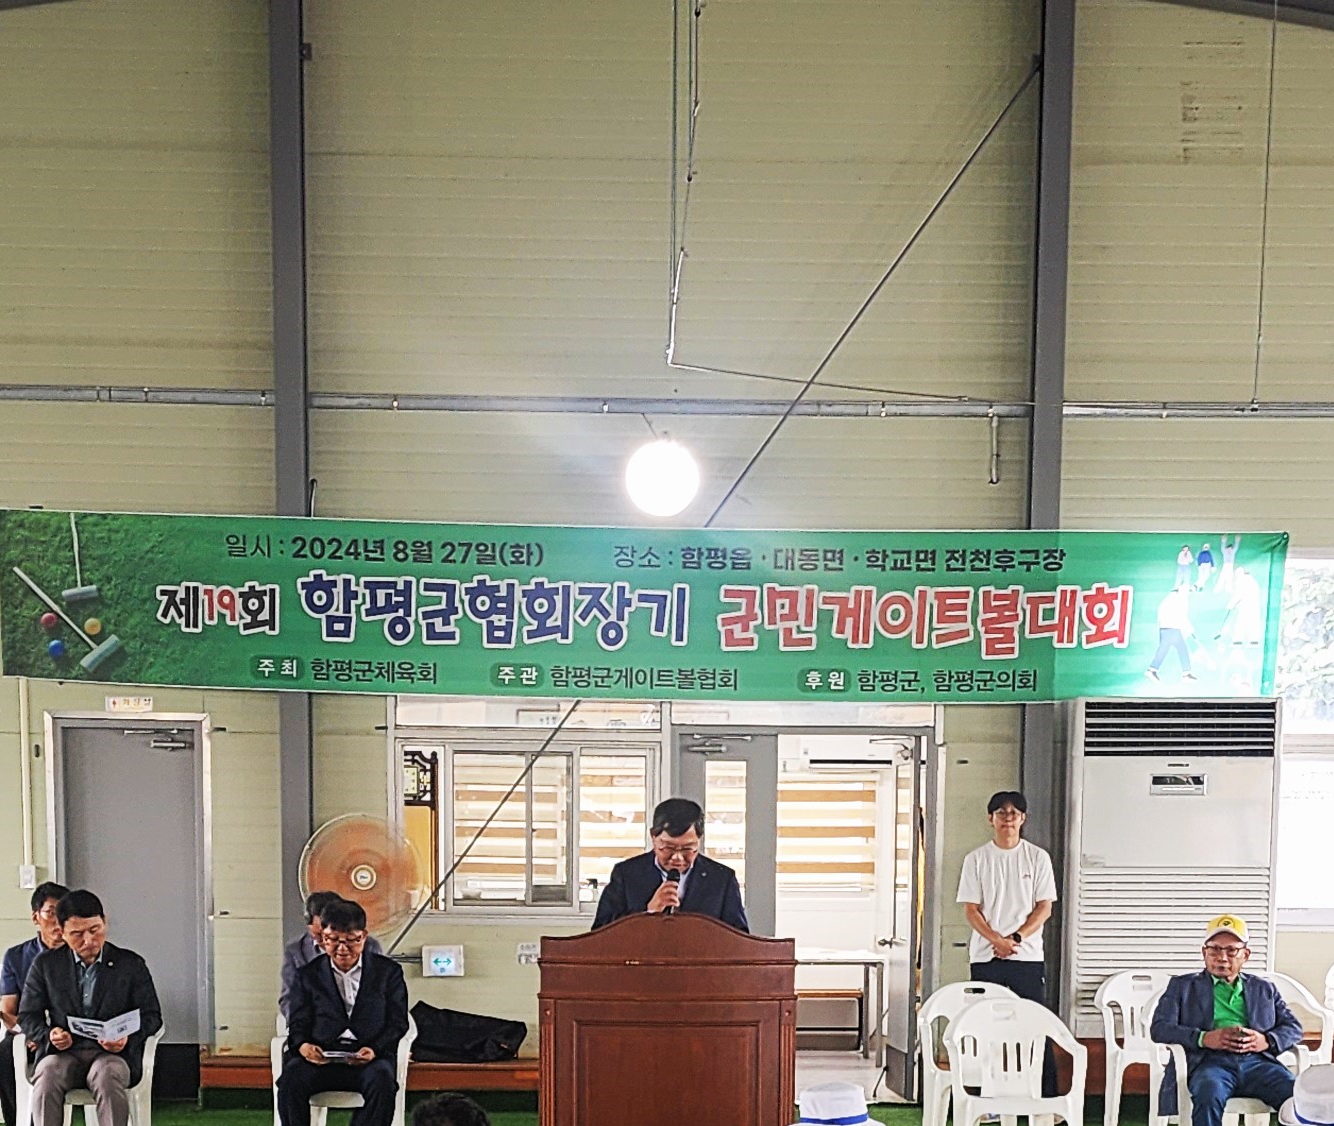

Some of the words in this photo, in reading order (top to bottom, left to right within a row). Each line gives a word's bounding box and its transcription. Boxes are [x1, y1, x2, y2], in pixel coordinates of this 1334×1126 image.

[225, 534, 272, 559] 일시
[290, 535, 386, 563] 2024년
[392, 539, 434, 564] 8월
[440, 540, 545, 567] 27일(화)
[613, 544, 661, 569] 장소
[680, 546, 753, 571] 함평읍
[772, 547, 844, 572] 대동면
[865, 548, 937, 573] 학교면
[944, 548, 1067, 573] 전천후구장
[157, 582, 279, 635] 제19회
[299, 572, 688, 649] 함평군협회장기
[720, 584, 1130, 657] 군민게이트볼대회
[310, 658, 438, 685] 함평군체육회
[549, 665, 739, 691] 함평군게이트볼협회
[857, 668, 927, 694] 함평군,
[932, 668, 1038, 693] 함평군의회
